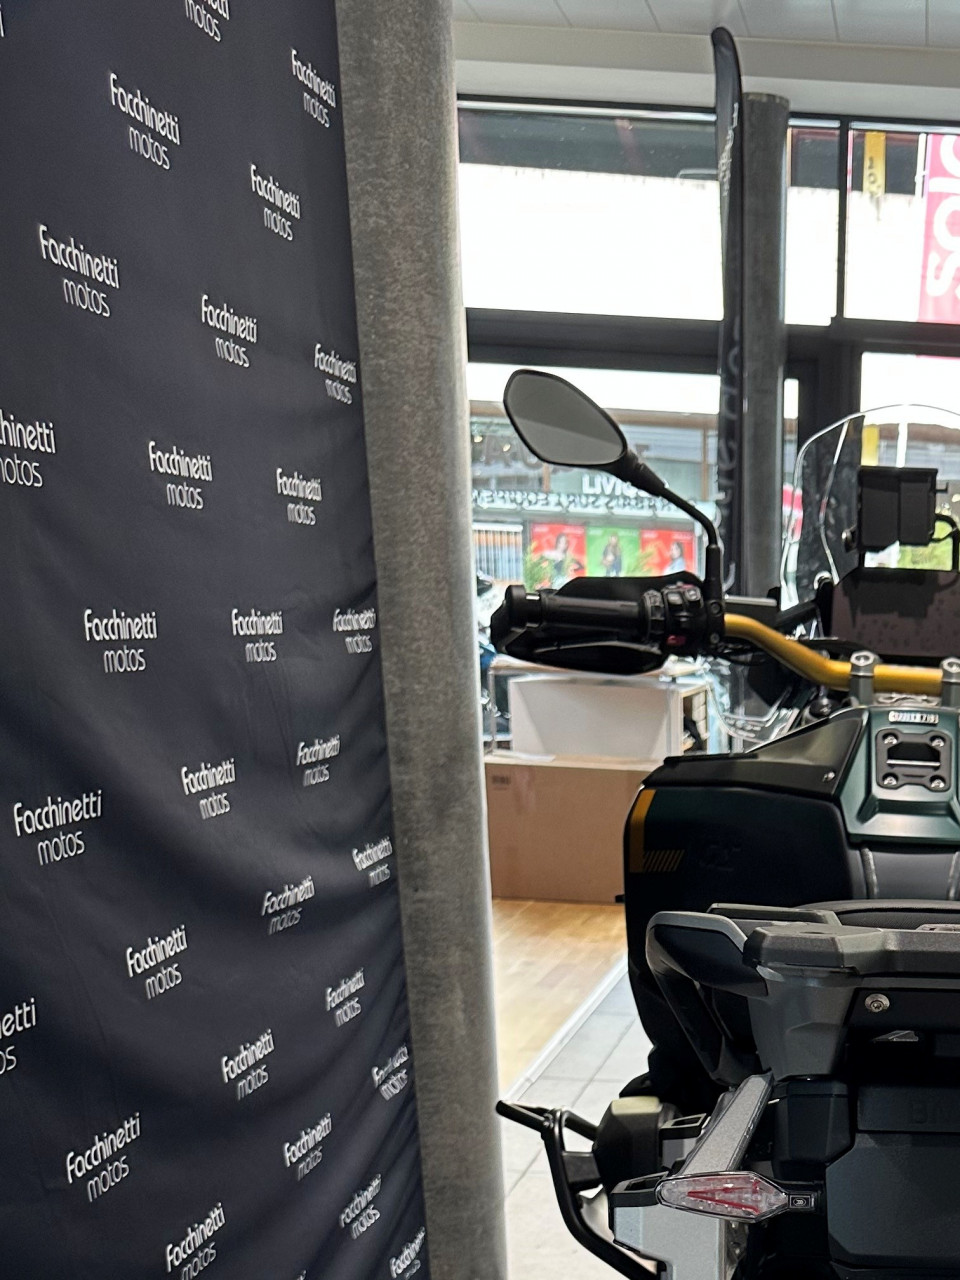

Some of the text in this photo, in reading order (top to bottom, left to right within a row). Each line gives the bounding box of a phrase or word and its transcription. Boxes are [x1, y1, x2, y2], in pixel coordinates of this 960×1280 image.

[291, 48, 336, 108] Facchinetti
[110, 71, 180, 145] Facchinetti
[303, 90, 331, 128] motos
[129, 126, 170, 170] motos
[250, 163, 300, 219] Facchinetti
[263, 206, 293, 241] motos
[38, 224, 120, 289] Facchinetti
[63, 278, 111, 318] motos
[201, 295, 257, 343] Facchinetti
[215, 337, 250, 368] motos
[315, 343, 357, 383] Facchinetti
[0, 410, 56, 454] hinetti
[149, 441, 213, 482] Facchinetti
[167, 482, 204, 510] motos
[277, 468, 322, 501] Facchinetti
[84, 608, 157, 641] Facchinetti
[232, 609, 283, 636] Facchinetti
[332, 608, 376, 633] Facchinetti
[104, 648, 146, 673] motos
[296, 735, 340, 766] Facchinetti
[181, 758, 235, 796] Facchinetti
[14, 790, 101, 836] Facchinetti
[199, 792, 231, 819] motos
[37, 831, 85, 866] motos
[352, 837, 392, 871] Facchinetti
[261, 876, 315, 917] Facchinetti
[126, 925, 188, 977] Facchinetti
[146, 962, 182, 1000] motos
[326, 969, 365, 1011] Facchinetti
[222, 1029, 274, 1083] Facchinetti
[237, 1064, 269, 1100] motos
[66, 1112, 141, 1185] Facchinetti
[284, 1113, 332, 1168] Facchinetti
[87, 1154, 130, 1202] motos
[166, 1202, 226, 1274] Facchinetti
